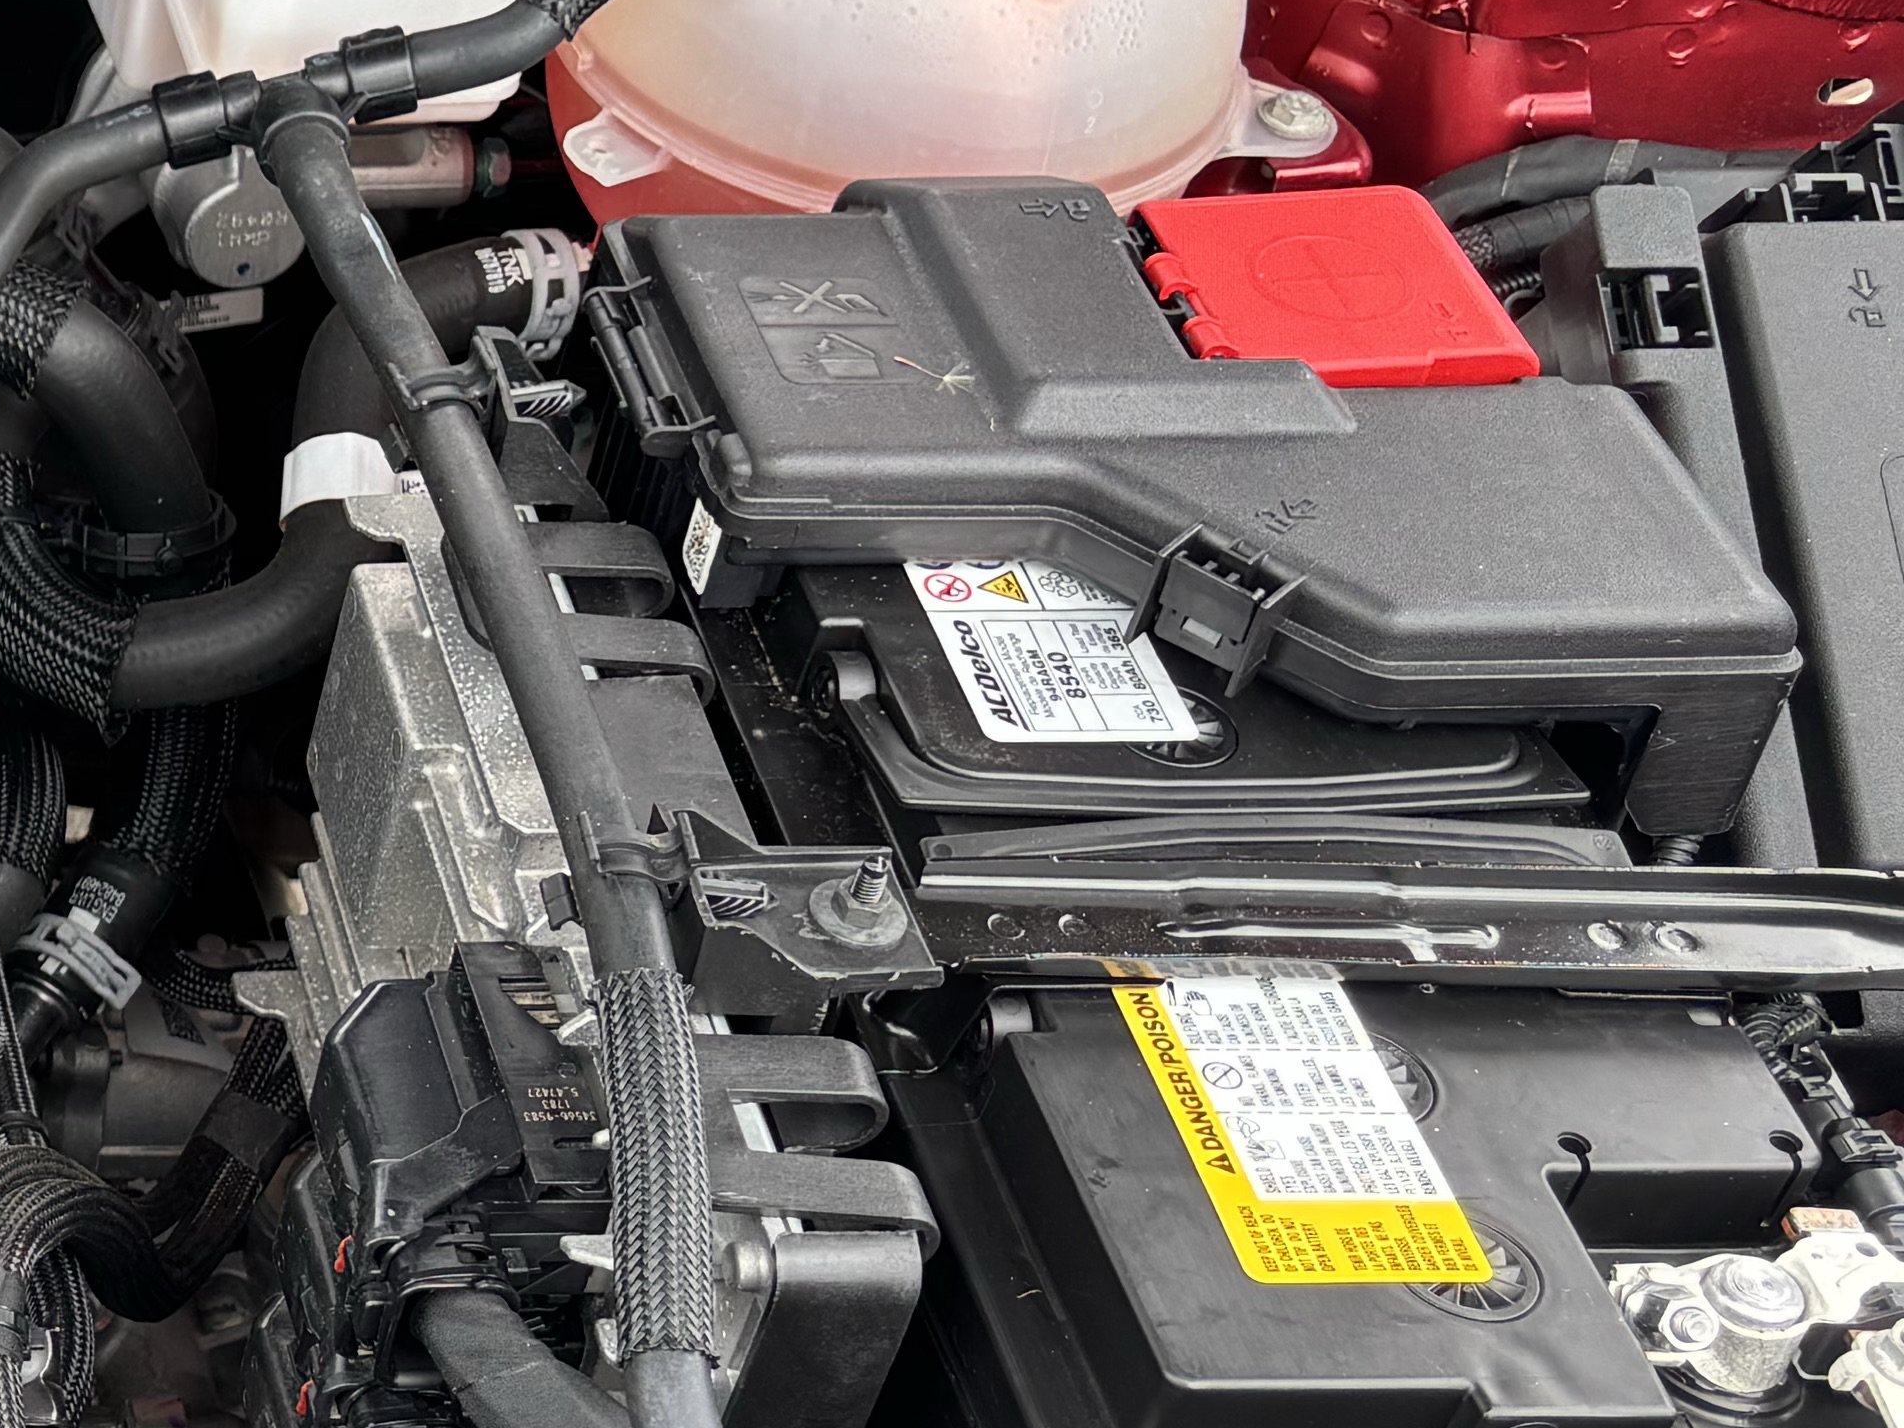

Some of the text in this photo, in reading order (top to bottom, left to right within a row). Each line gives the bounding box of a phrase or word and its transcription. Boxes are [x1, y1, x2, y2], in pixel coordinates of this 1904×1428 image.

[497, 247, 525, 287] TNK
[1102, 627, 1125, 650] 365
[943, 619, 1021, 727] ACDelco
[1025, 649, 1062, 701] 94RAGM
[1045, 652, 1087, 698] 8540
[1118, 660, 1147, 689] 80Ah
[1141, 700, 1164, 722] 730
[1124, 990, 1227, 1150] DANGER/POISON
[541, 1099, 571, 1110] 1783
